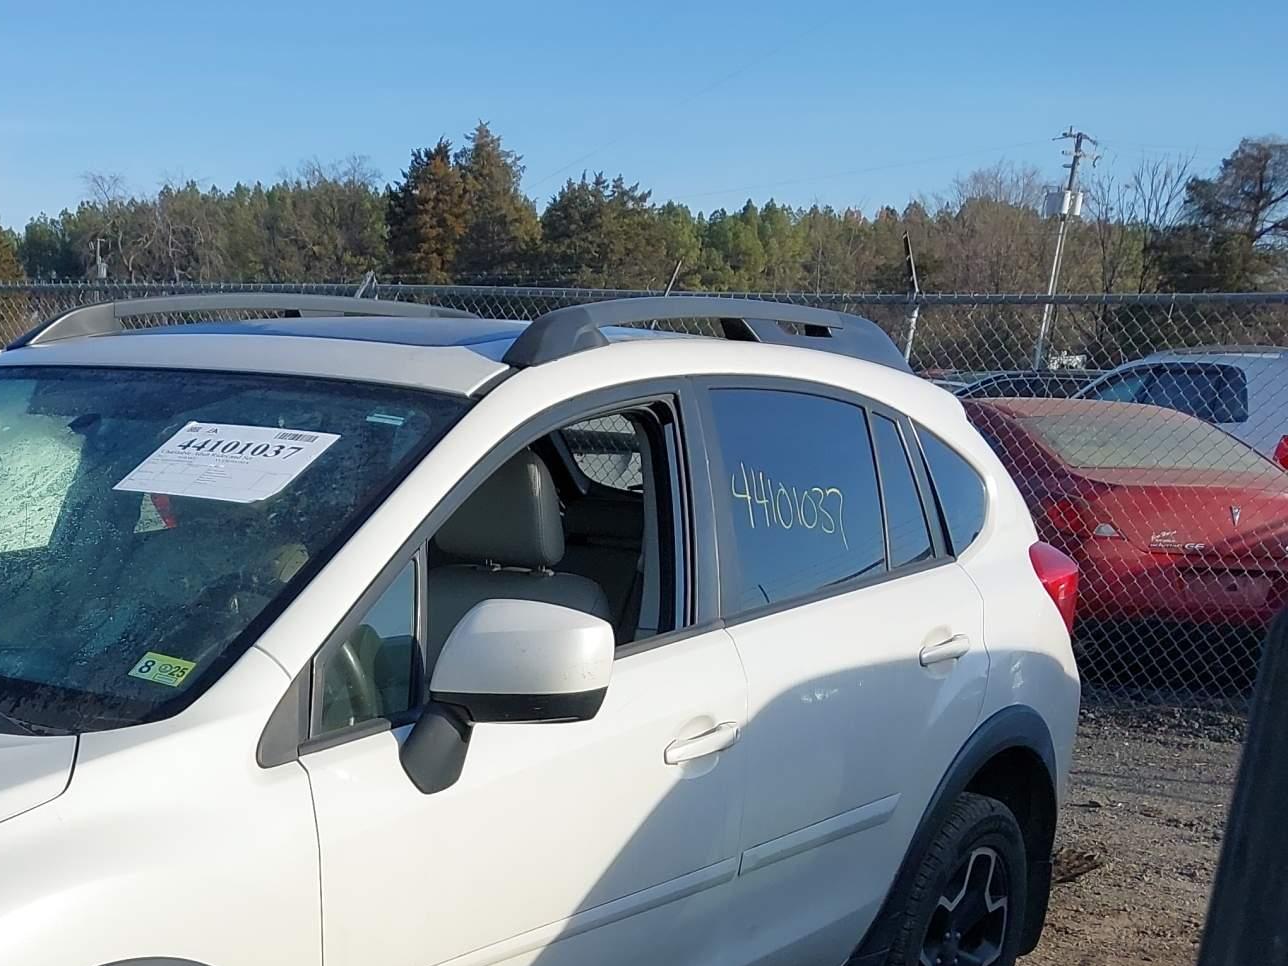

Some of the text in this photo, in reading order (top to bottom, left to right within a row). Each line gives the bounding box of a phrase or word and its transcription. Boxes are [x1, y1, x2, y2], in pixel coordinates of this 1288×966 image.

[177, 438, 304, 460] 44101037
[731, 461, 848, 550] 44101037
[139, 660, 188, 677] 8 25
